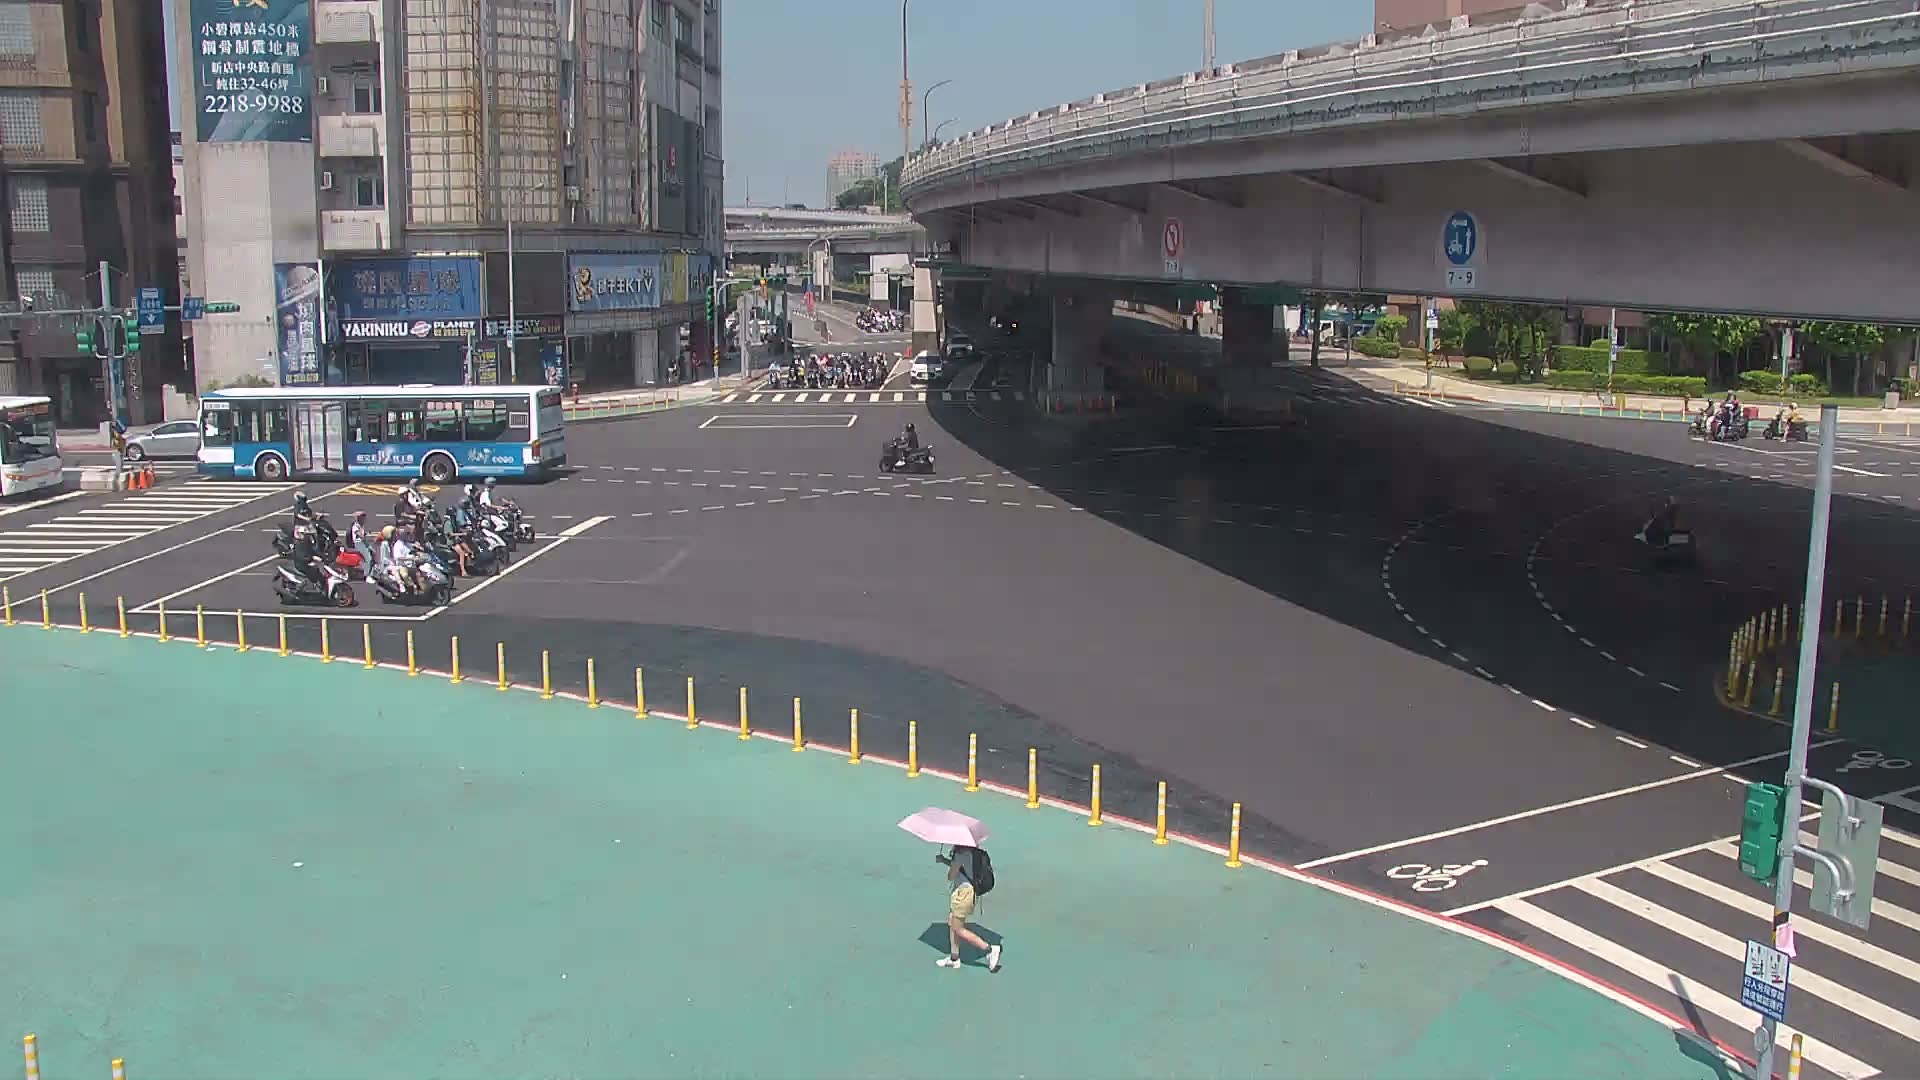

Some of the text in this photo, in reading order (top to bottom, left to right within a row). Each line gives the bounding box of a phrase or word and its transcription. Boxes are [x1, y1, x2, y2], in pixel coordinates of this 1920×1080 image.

[201, 21, 299, 38] 小碧潭站450米
[211, 61, 294, 75] 新店中央路商圈
[205, 94, 303, 114] 2218-9988
[342, 321, 476, 337] YAKINIKU PLANET
